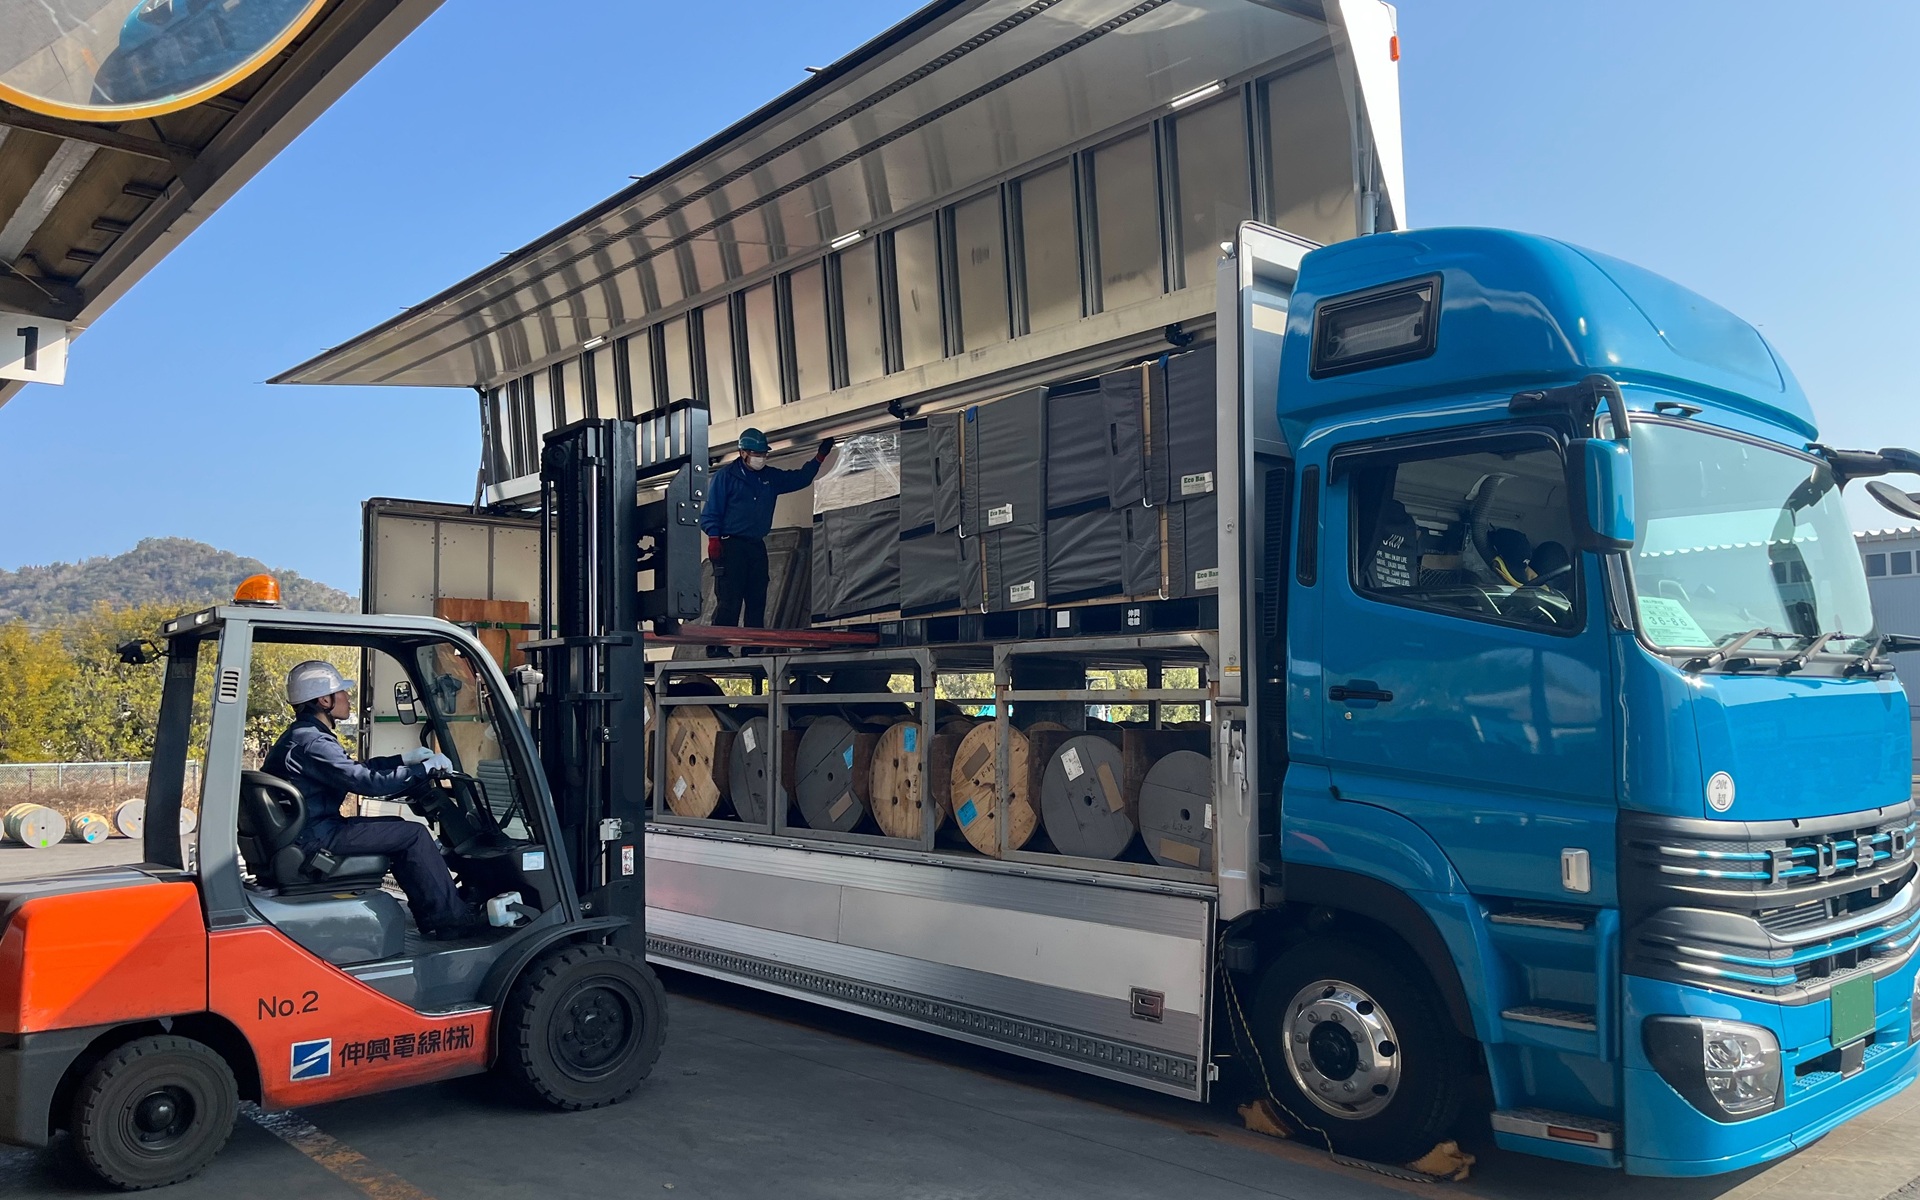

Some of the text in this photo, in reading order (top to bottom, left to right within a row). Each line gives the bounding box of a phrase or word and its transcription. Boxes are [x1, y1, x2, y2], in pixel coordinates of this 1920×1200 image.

[17, 326, 38, 371] 1
[1715, 779, 1728, 790] 20t
[1770, 828, 1907, 884] FUSO
[257, 990, 319, 1020] No.2
[338, 1024, 474, 1068] 伸興電線(株)
